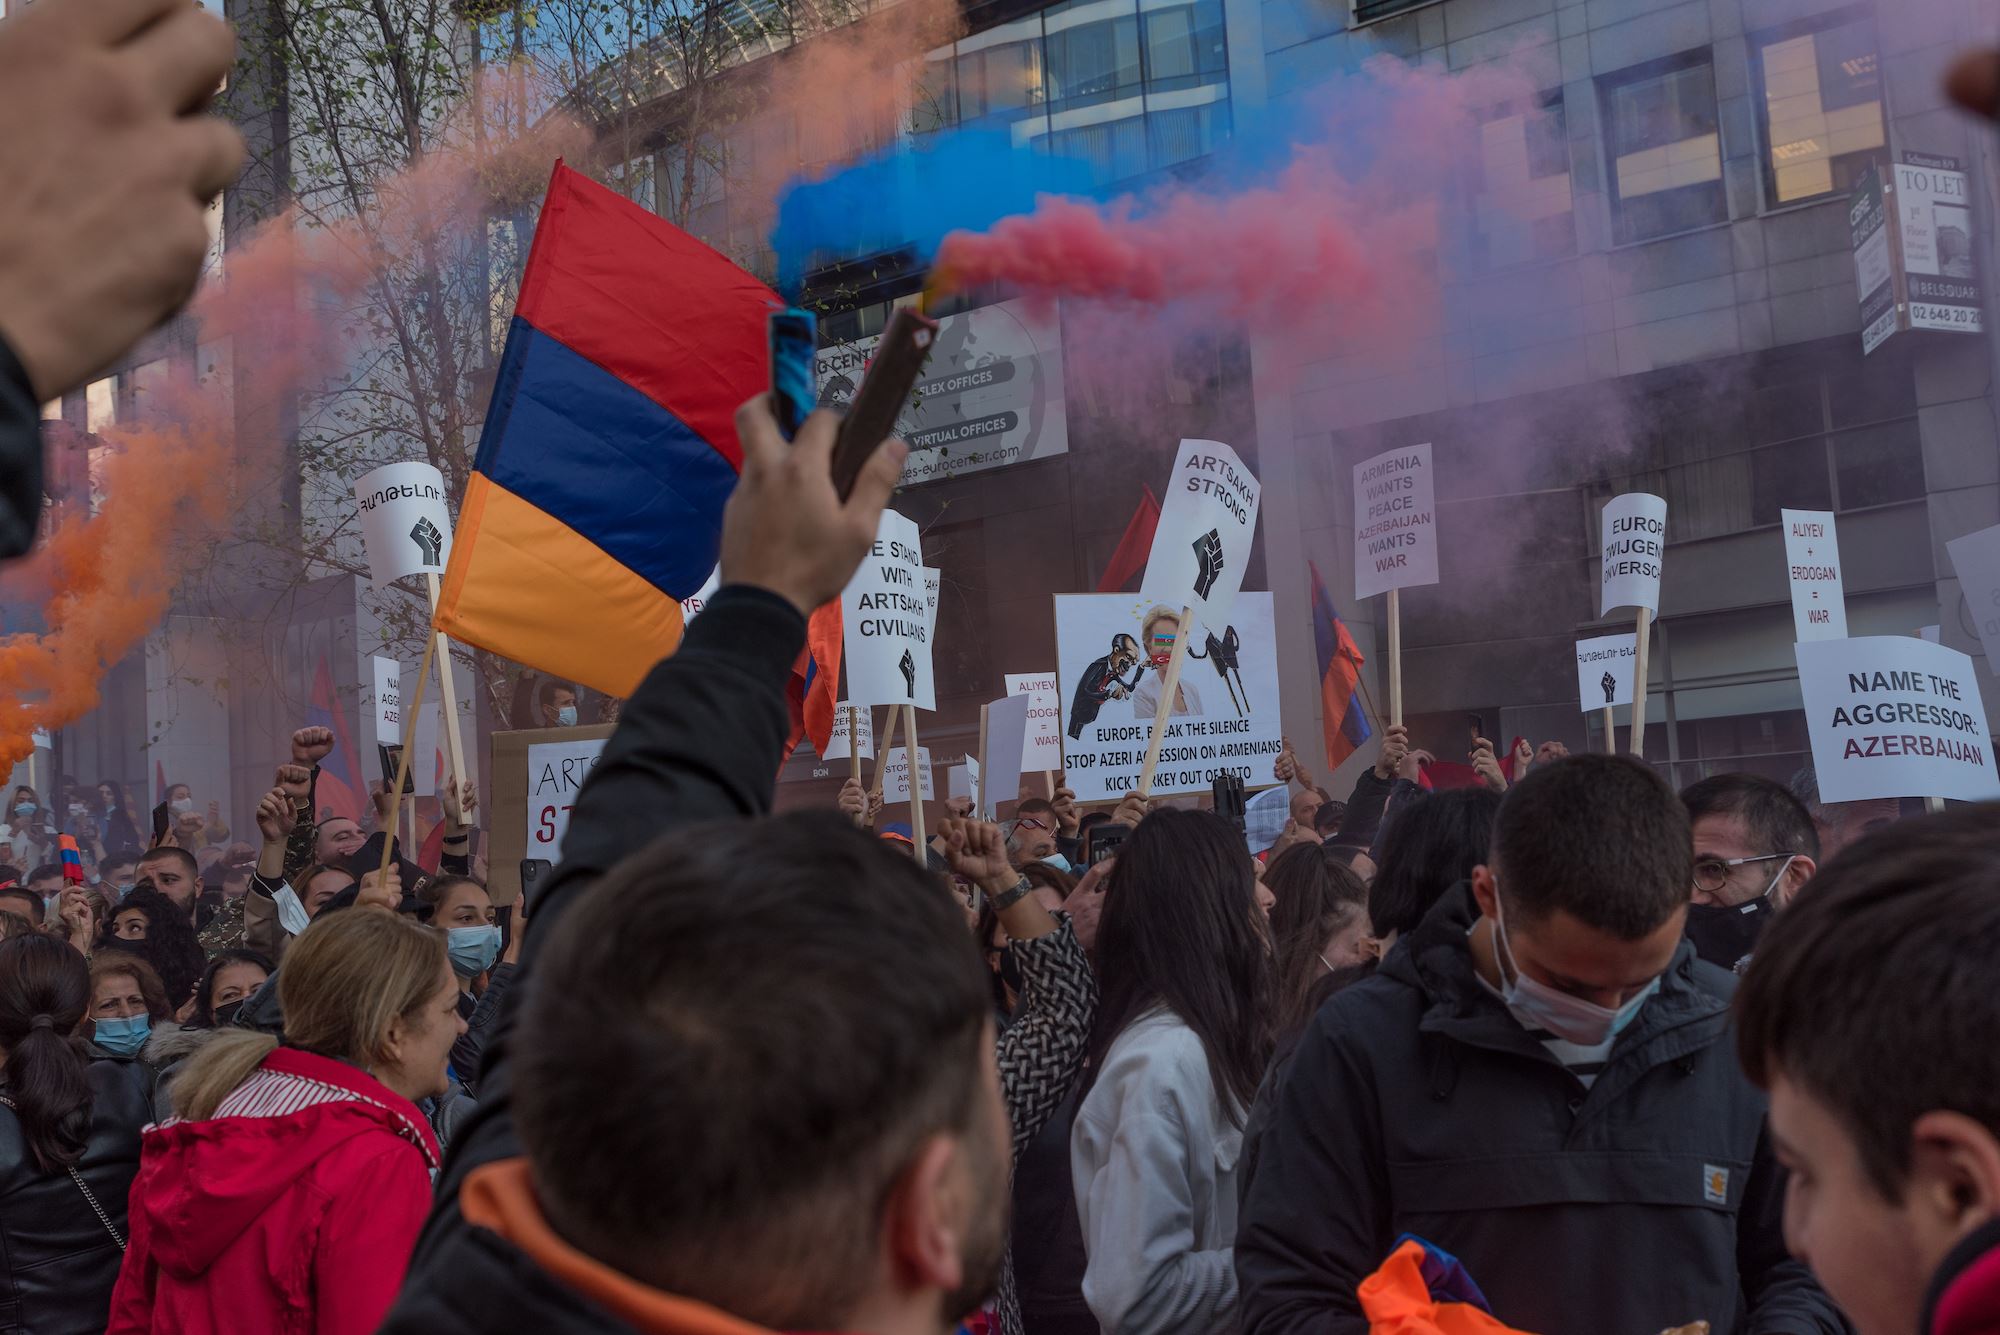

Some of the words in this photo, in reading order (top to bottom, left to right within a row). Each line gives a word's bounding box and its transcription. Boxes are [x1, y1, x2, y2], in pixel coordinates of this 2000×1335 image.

[1902, 170, 1928, 192] TO
[1933, 174, 1964, 196] LET
[1920, 281, 1977, 300] BELSQUAR
[1912, 305, 1927, 319] 02
[1929, 307, 1951, 321] 648
[1953, 310, 1968, 322] 20
[946, 370, 993, 391] OFFICES
[913, 427, 958, 447] VIRTUAL
[960, 418, 1007, 437] OFFICES
[903, 446, 1020, 479] es-eurocener.com
[1361, 455, 1421, 485] ARMENIA
[1185, 454, 1254, 507] ARTSAKH
[1366, 476, 1413, 500] WANTS
[1187, 477, 1247, 525] STRONG
[1368, 496, 1413, 520] PEACE
[1358, 512, 1431, 541] AZERBAIJAN
[1792, 523, 1824, 538] ALIYEV
[890, 541, 919, 567] STAND
[1368, 532, 1416, 556] WANTS
[1606, 539, 1663, 562] ZWIJGEN
[1376, 553, 1407, 573] WAR
[1792, 566, 1836, 581] ERDOGAN
[881, 566, 913, 588] WITH
[858, 593, 924, 617] ARTSAKH
[1808, 609, 1830, 624] WAR
[860, 619, 926, 643] CIVILIANS
[1019, 680, 1056, 692] ALIYEV
[1848, 671, 1926, 693] NAME
[1928, 674, 1961, 701] THE
[1025, 708, 1058, 720] RDOGA
[1832, 703, 1979, 736] AGGRESSOR:
[1035, 735, 1060, 747] WAR
[1097, 726, 1144, 742] EUROPE,
[1185, 723, 1207, 736] THE
[1209, 719, 1250, 735] SILENCE
[1066, 754, 1096, 769] STOP
[1099, 751, 1132, 767] AZERI
[1200, 745, 1217, 759] ON
[1220, 740, 1281, 757] ARMENIANS
[1843, 735, 1984, 767] AZERBAIJAN
[1106, 776, 1132, 791] KICK
[1134, 772, 1176, 788] TRKEY
[1180, 770, 1203, 785] OUT
[1205, 769, 1218, 783] OF
